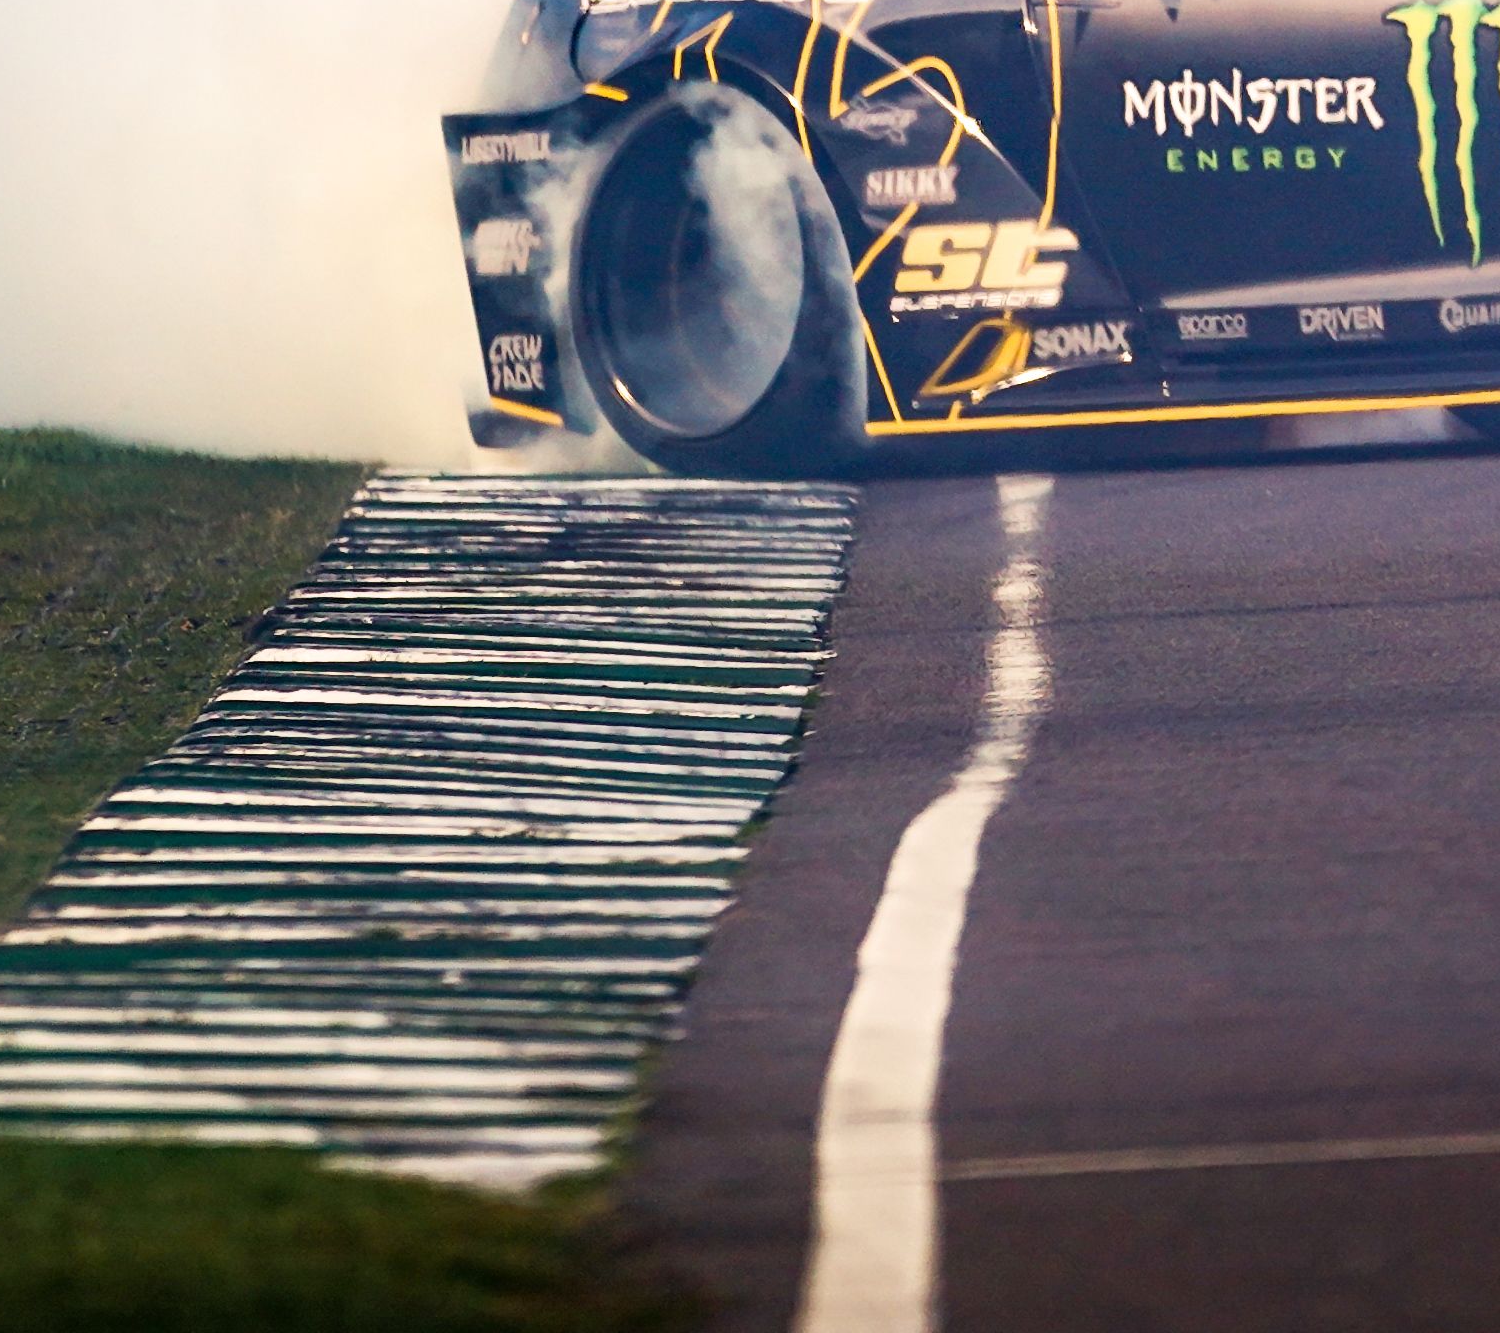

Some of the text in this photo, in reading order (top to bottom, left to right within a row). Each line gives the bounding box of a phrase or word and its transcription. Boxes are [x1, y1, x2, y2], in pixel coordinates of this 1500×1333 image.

[1123, 67, 1386, 138] MONSTER
[1166, 146, 1347, 173] ENERGY
[867, 164, 958, 197] SIKKY
[1178, 312, 1248, 334] sparco
[1301, 304, 1385, 337] DRIVEN
[1032, 319, 1132, 359] SONAX
